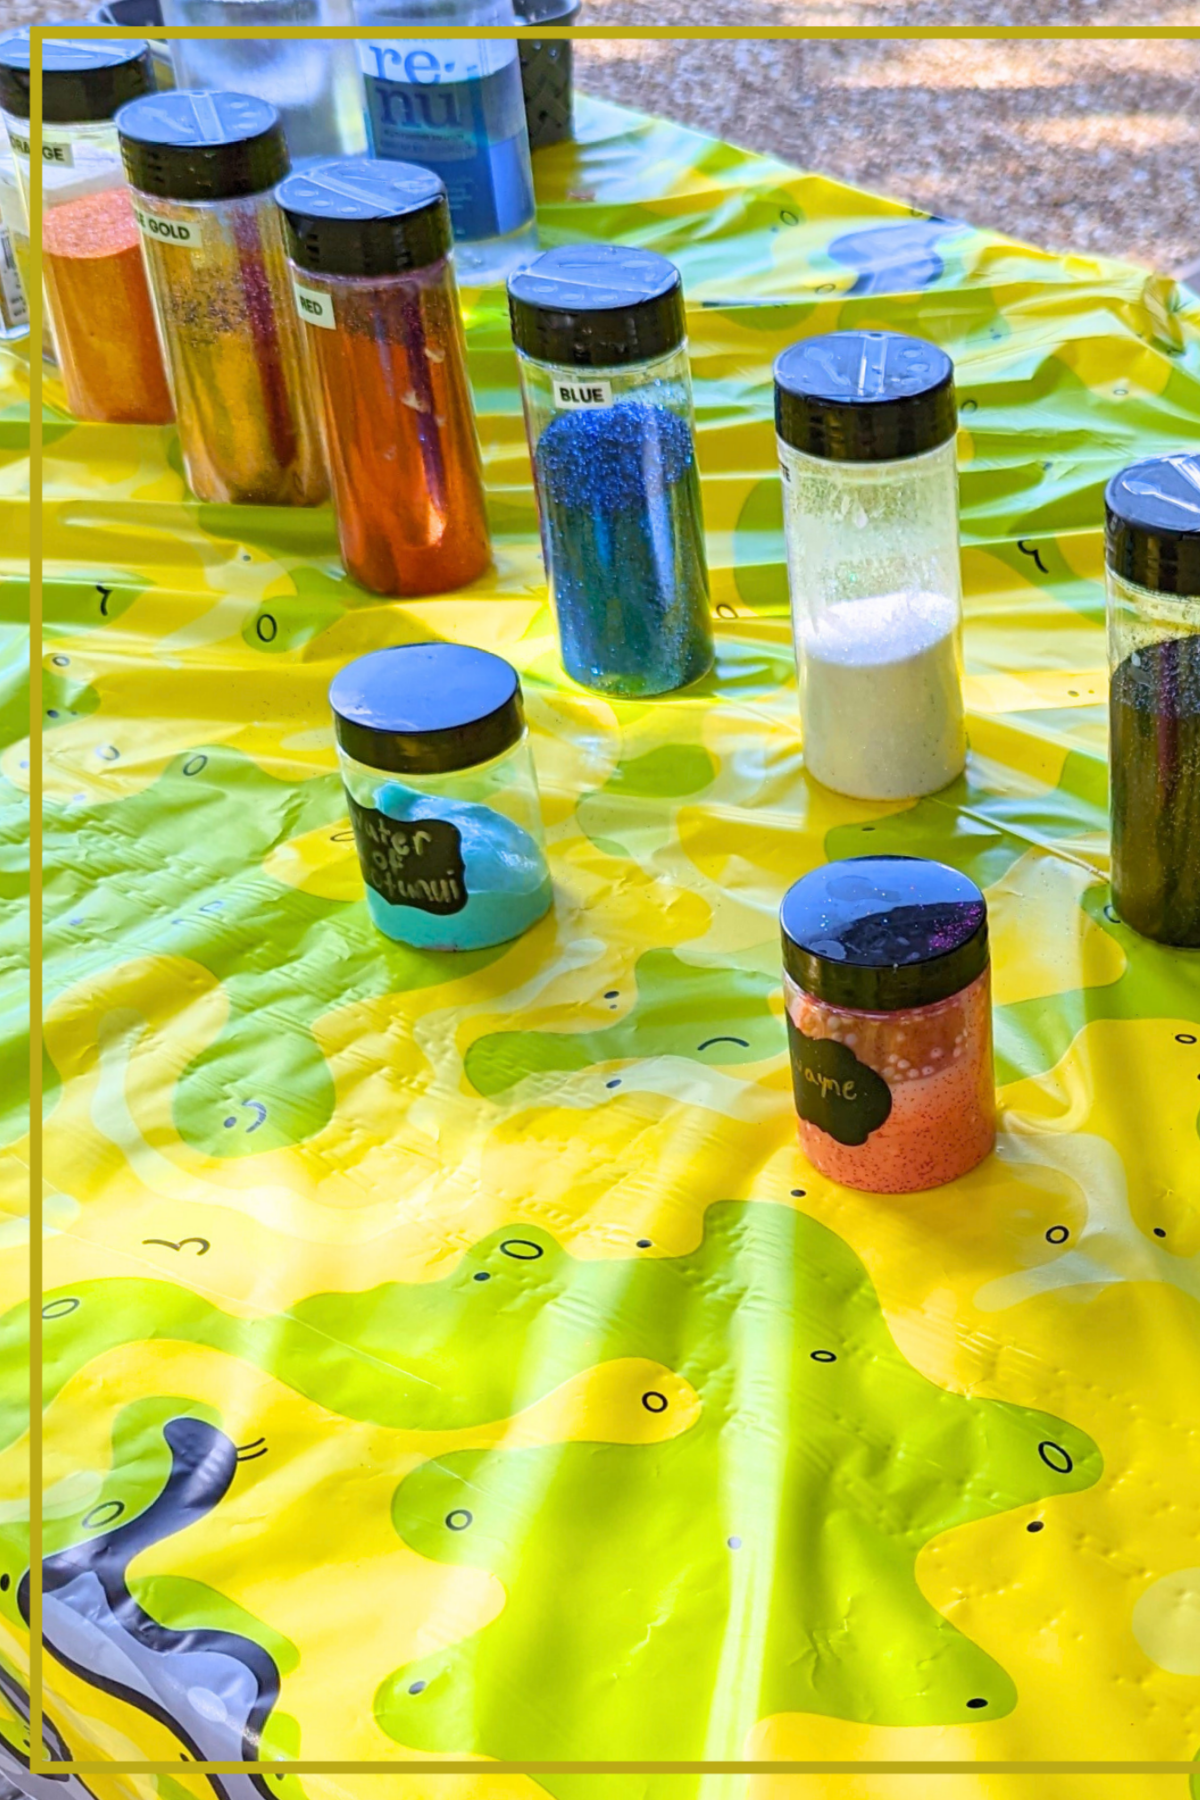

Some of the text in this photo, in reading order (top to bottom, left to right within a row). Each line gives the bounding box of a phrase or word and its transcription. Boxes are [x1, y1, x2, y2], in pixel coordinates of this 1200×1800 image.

[375, 87, 462, 128] nu
[10, 135, 66, 162] ORAGE
[149, 218, 190, 240] GOLD
[300, 295, 323, 316] RED
[559, 387, 605, 403] BLUE
